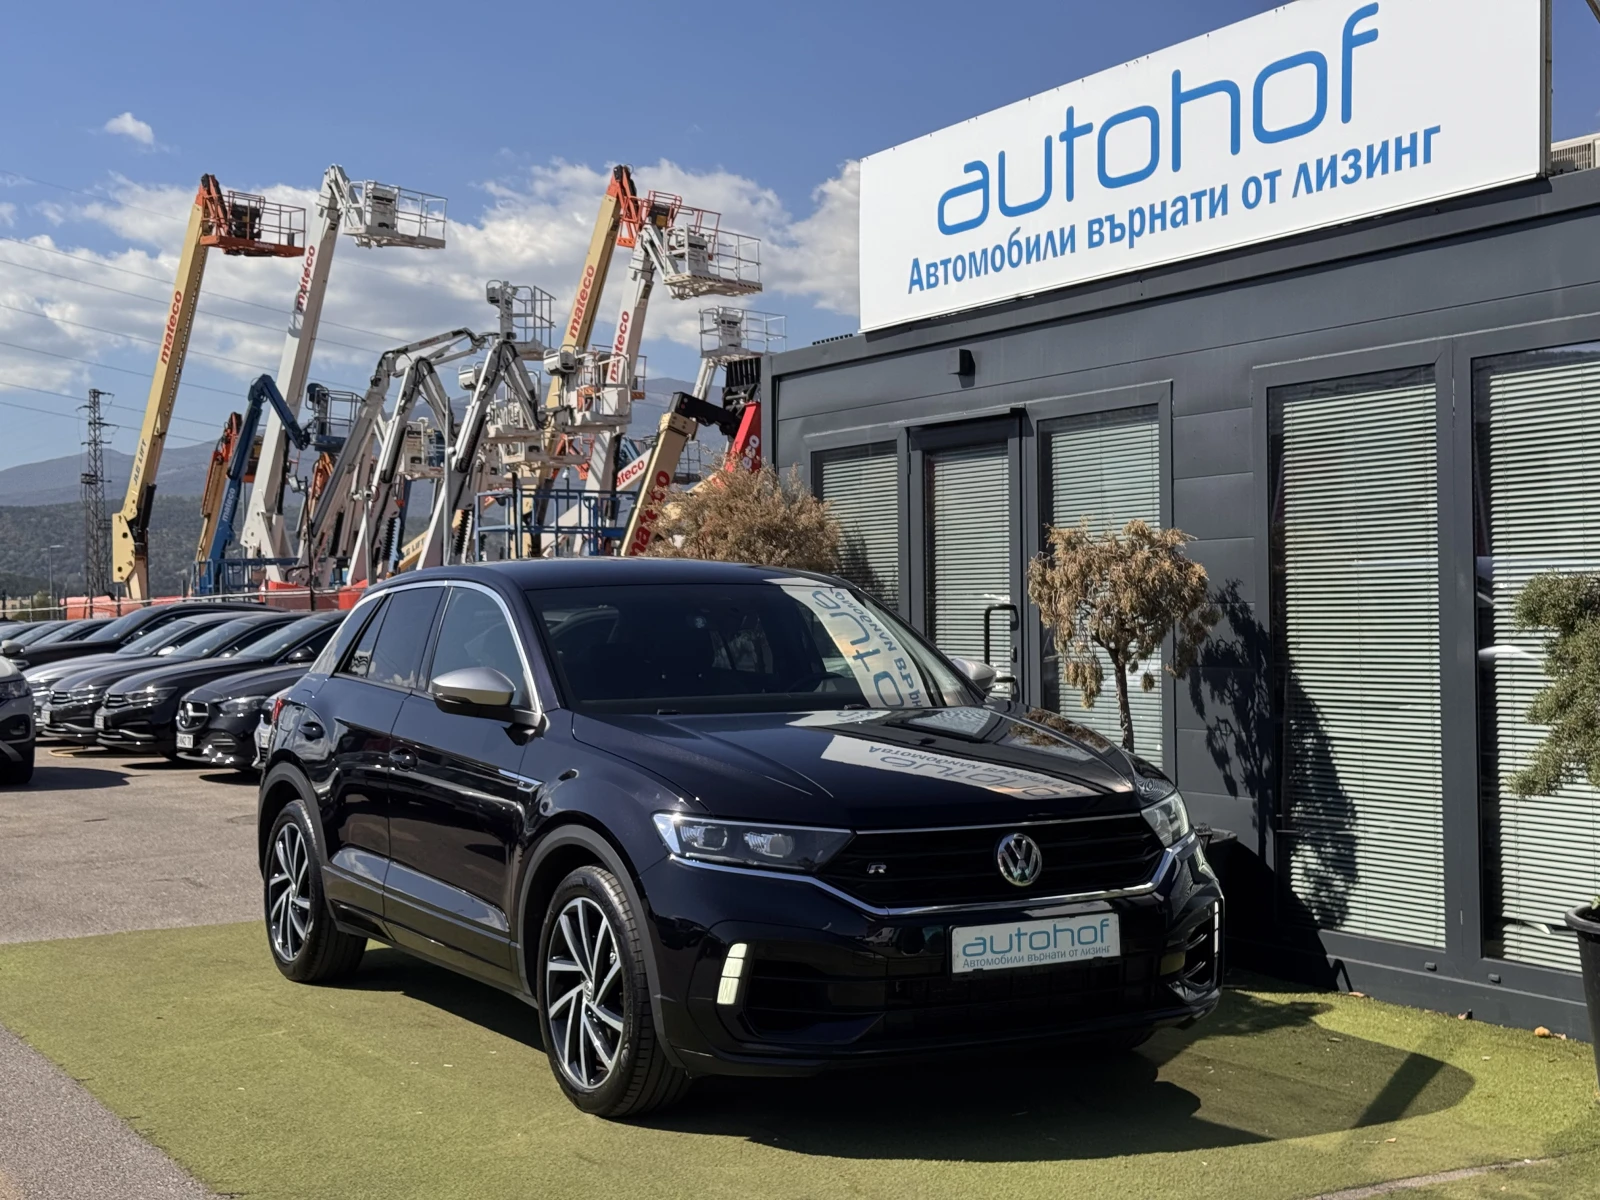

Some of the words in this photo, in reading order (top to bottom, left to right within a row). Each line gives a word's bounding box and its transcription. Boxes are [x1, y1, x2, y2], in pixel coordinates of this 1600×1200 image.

[937, 3, 1379, 236] autohof
[908, 225, 1076, 294] Автомобили
[1087, 184, 1229, 249] върнати
[1240, 168, 1283, 210] от
[1292, 125, 1441, 197] лизинг
[296, 245, 315, 313] mateco
[569, 265, 595, 339] mateco
[161, 290, 182, 365] mateco
[609, 311, 630, 382] mteco
[962, 917, 1110, 957] autohof
[962, 953, 1025, 969] Автомобили
[1027, 950, 1067, 963] върнати
[1068, 948, 1079, 958] от
[1080, 945, 1111, 957] лизинг
